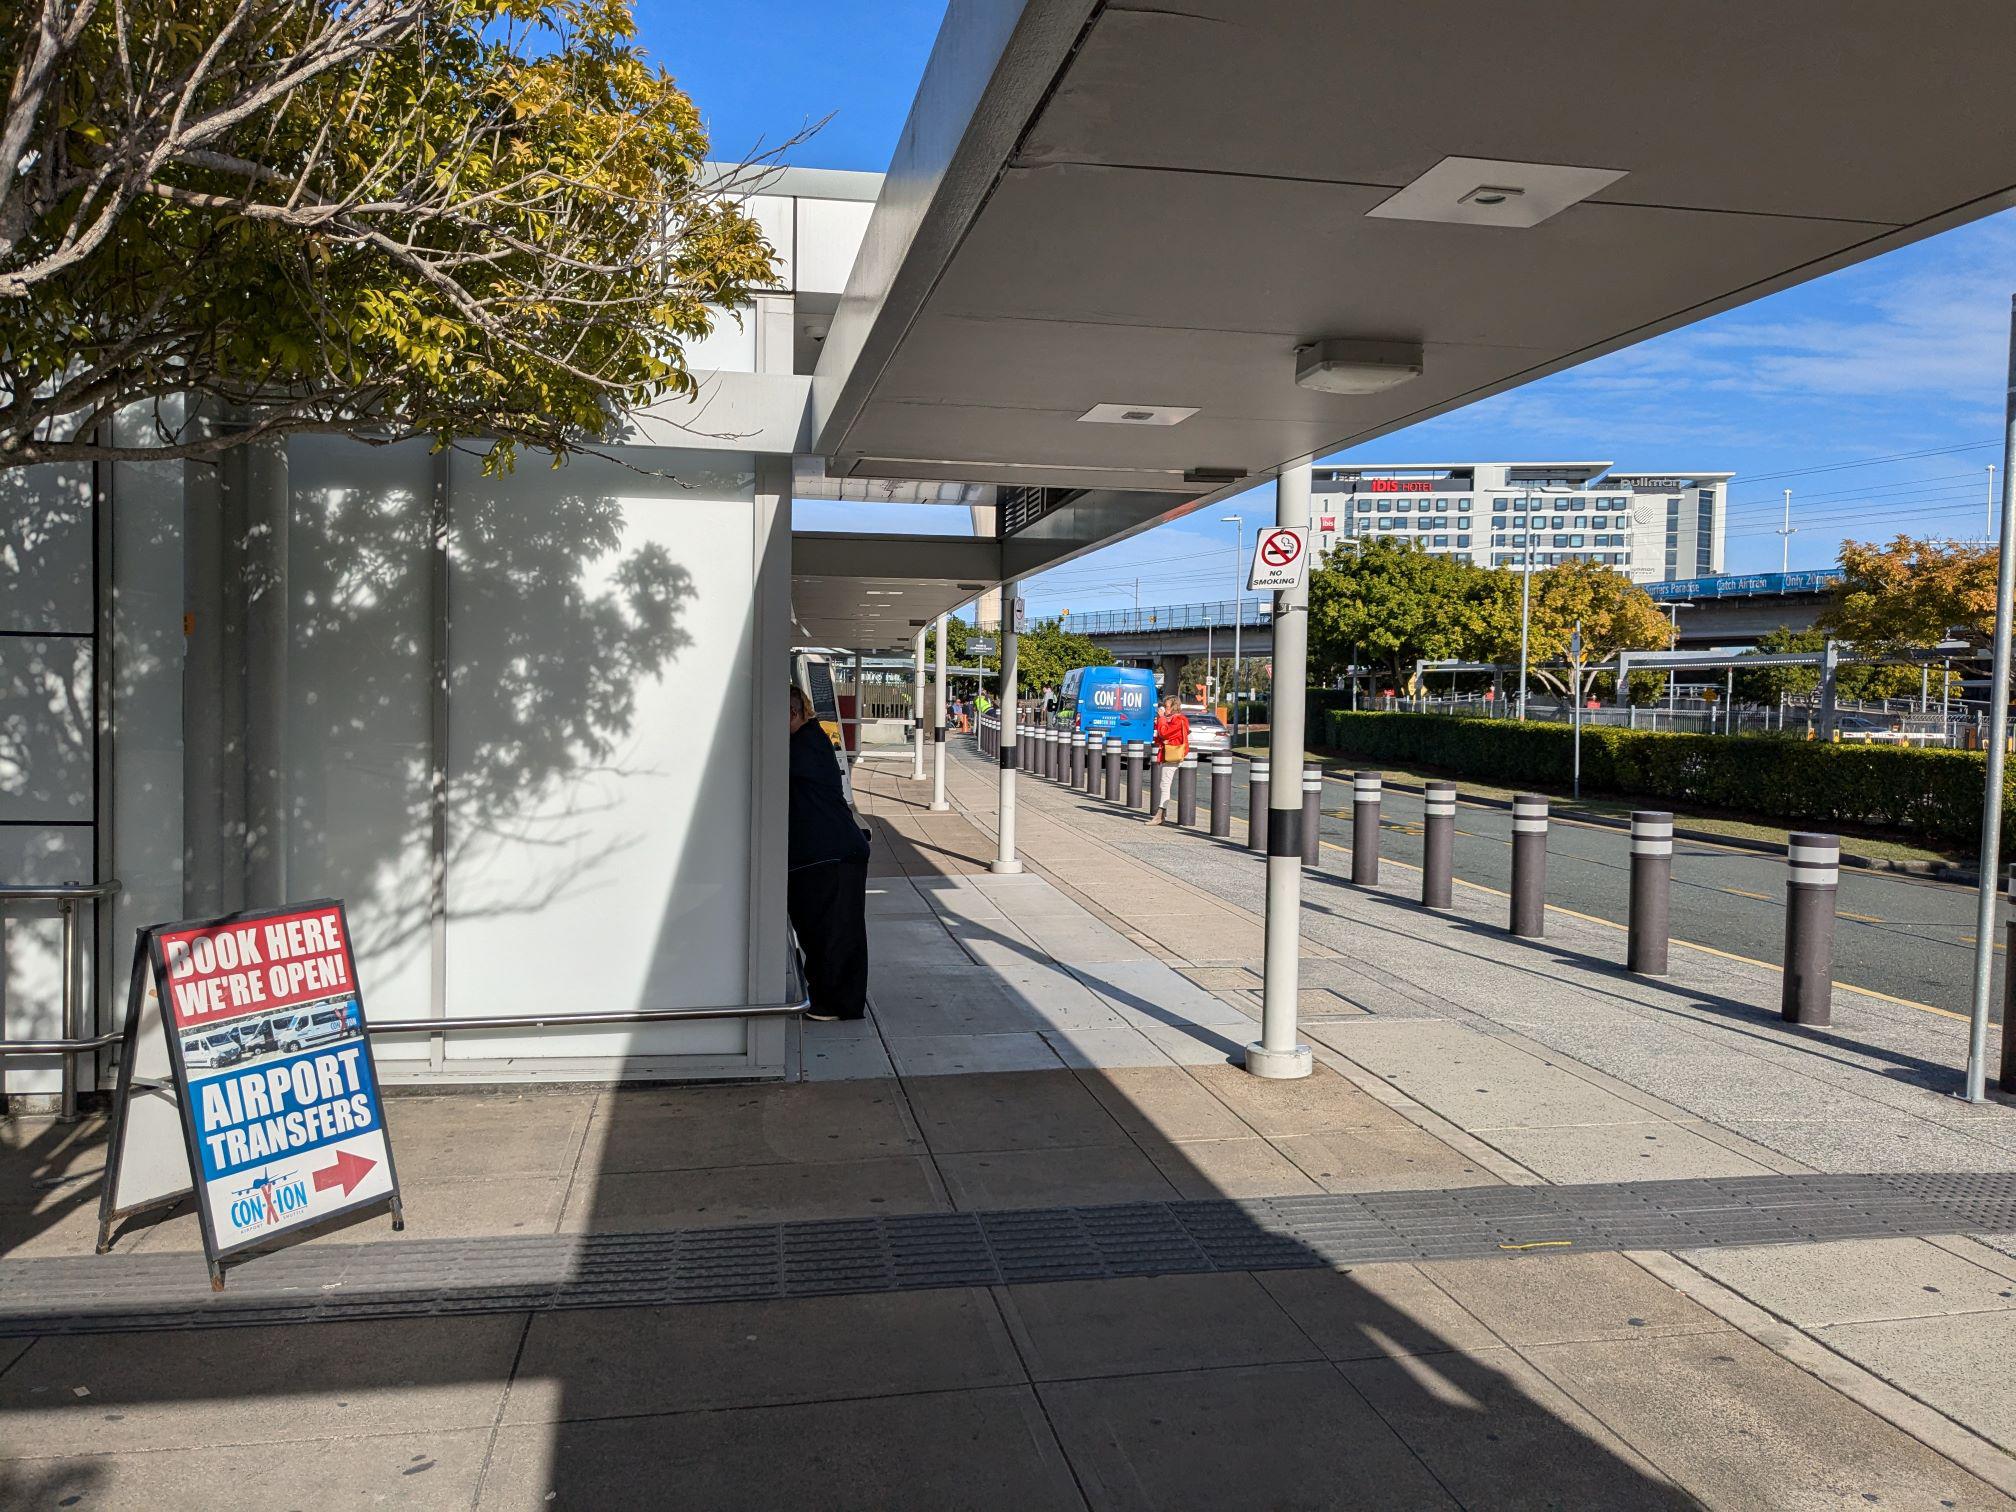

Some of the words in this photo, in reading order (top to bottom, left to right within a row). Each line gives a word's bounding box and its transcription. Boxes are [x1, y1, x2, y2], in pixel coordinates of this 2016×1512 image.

[1372, 479, 1399, 492] ibis
[1402, 482, 1433, 492] HOTEL
[1321, 520, 1335, 528] ibis
[1253, 577, 1295, 586] SMOKING
[1670, 582, 1700, 594] Paradise
[1716, 579, 1736, 591] Catch
[1785, 574, 1804, 588] Only
[167, 928, 261, 979] BOOK
[266, 914, 342, 961] HERE
[175, 973, 267, 1018] WE'RE
[269, 953, 347, 998] OPEN!
[202, 1048, 361, 1132] AIRPORT
[206, 1094, 373, 1171] TRANSFERS
[240, 1223, 264, 1234] AIRPORT
[282, 1210, 304, 1220] SHUTTLE
